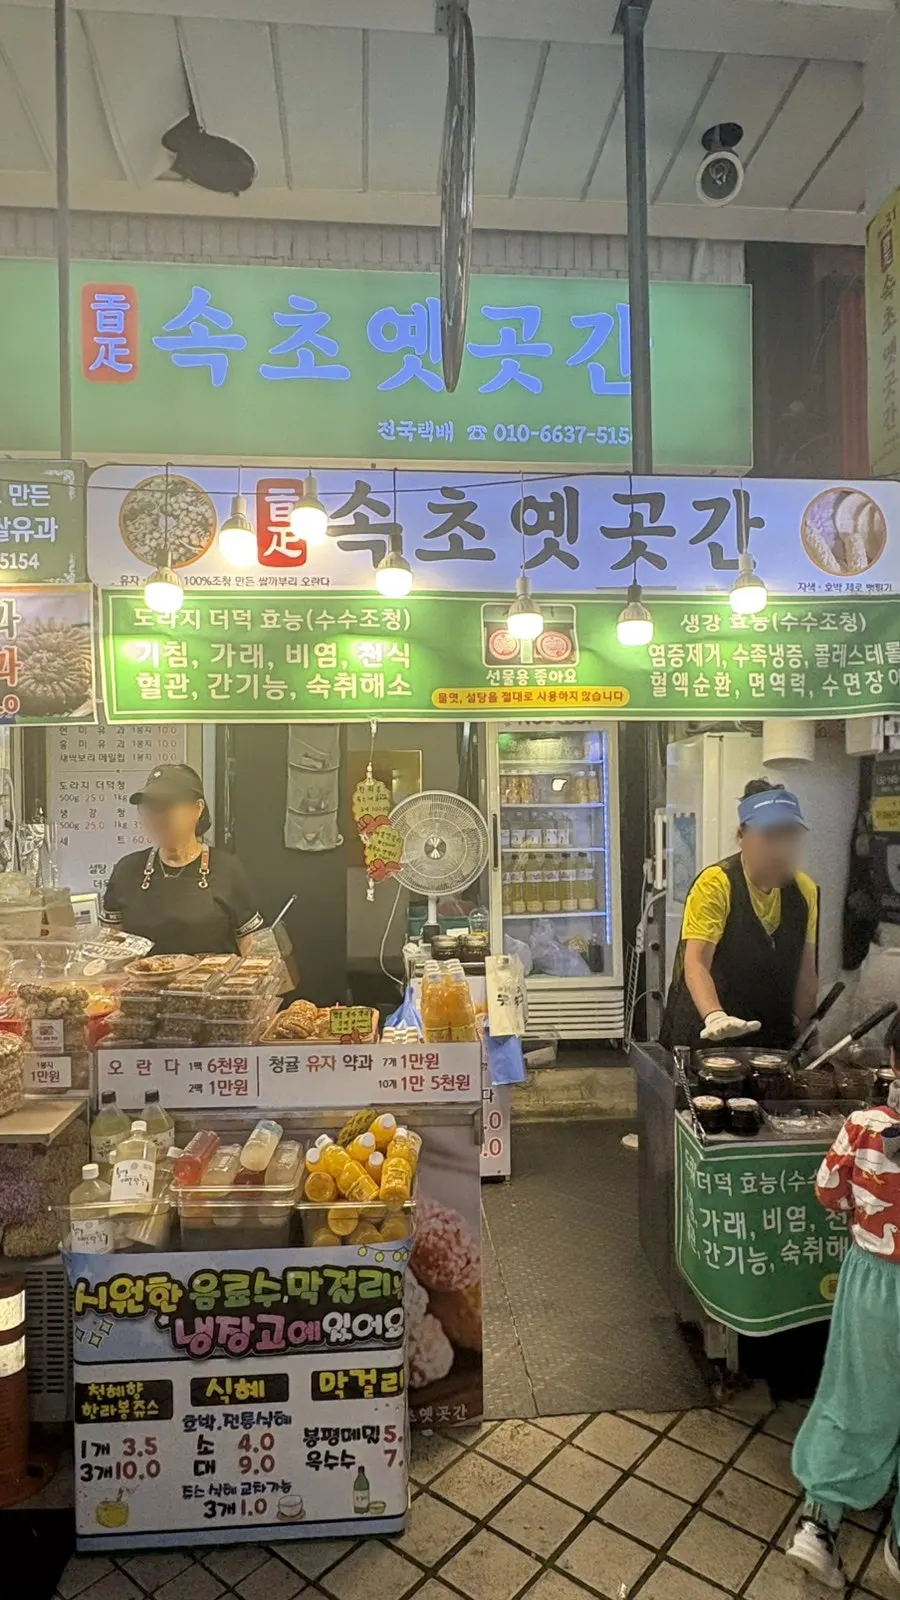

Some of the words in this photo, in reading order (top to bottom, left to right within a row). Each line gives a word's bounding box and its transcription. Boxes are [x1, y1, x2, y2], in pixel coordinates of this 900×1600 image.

[377, 420, 455, 442] 전국택배
[494, 423, 632, 445] 010-6637-515
[9, 483, 51, 507] 만든
[0, 551, 41, 571] 5154
[119, 575, 140, 586] 유자
[234, 575, 256, 587] 만든
[300, 575, 331, 587] 오란다
[208, 606, 252, 631] 더덕
[260, 605, 412, 632] 효능(수수조청)
[680, 611, 722, 633] 생강
[727, 611, 867, 633] 효능(수수조청)
[134, 641, 199, 669] 기침,
[209, 641, 275, 671] 가래,
[285, 641, 349, 670] 비염,
[648, 642, 728, 669] 염증제거,
[731, 642, 809, 669] 수족냉증,
[814, 641, 900, 668] 콜레스테롤
[136, 673, 199, 702] 혈관,
[207, 673, 298, 702] 간기능,
[305, 672, 413, 700] 숙취해소
[486, 668, 530, 687] 선물용
[533, 668, 578, 685] 좋아요
[649, 671, 740, 699] 혈액순환,
[747, 671, 814, 699] 면역력,
[465, 692, 499, 704] 설탕을
[501, 692, 533, 702] 절대로
[536, 691, 579, 702] 사용하지
[581, 690, 625, 703] 않습니다
[59, 780, 90, 790] 도라지
[59, 793, 80, 803] 500g
[59, 822, 80, 831] 500g
[113, 821, 128, 830] 1kg
[88, 863, 107, 875] 설탕
[207, 1057, 249, 1076] 6천원
[268, 1055, 301, 1074] 청귤
[305, 1055, 337, 1072] 유자
[342, 1053, 374, 1072] 약과
[382, 1056, 397, 1067] 7개
[401, 1052, 440, 1071] 1만원
[31, 1070, 61, 1084] 1만원
[209, 1078, 249, 1097] 1만원
[378, 1078, 397, 1090] 10개
[401, 1075, 425, 1092] 1만
[430, 1073, 471, 1092] 5천원
[697, 1171, 733, 1197] 더덕
[699, 1206, 756, 1241] 가래,
[762, 1205, 816, 1233] 비염,
[702, 1238, 775, 1277] 간기능,
[74, 1274, 184, 1314] 시원한
[87, 1381, 145, 1401] 천혜향
[204, 1377, 266, 1404] 식혜
[318, 1368, 403, 1400] 막걸리
[196, 1434, 216, 1457] 소
[236, 1432, 276, 1454] 4.0
[302, 1424, 382, 1448] 봉평메밀
[80, 1440, 112, 1460] 1개
[121, 1436, 159, 1458] 3.5
[79, 1463, 114, 1482] 3개
[114, 1459, 162, 1481] 10.0
[193, 1458, 217, 1478] 대
[237, 1454, 277, 1475] 9.0
[304, 1449, 358, 1472] 옥수수
[202, 1500, 237, 1519] 3개
